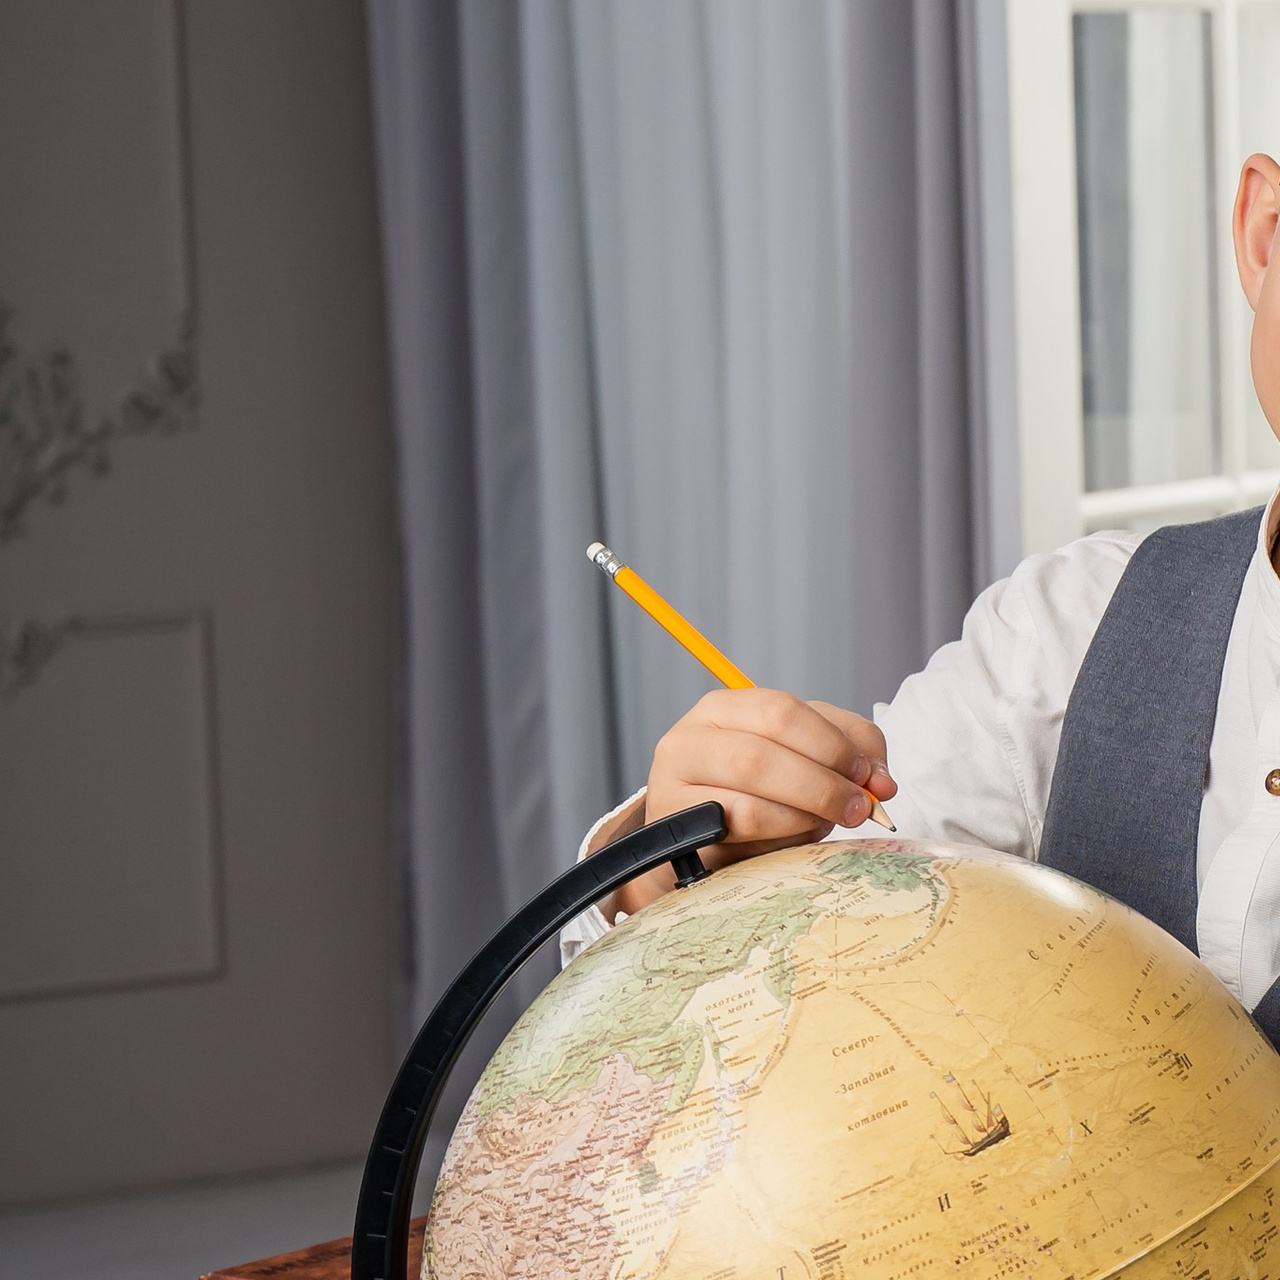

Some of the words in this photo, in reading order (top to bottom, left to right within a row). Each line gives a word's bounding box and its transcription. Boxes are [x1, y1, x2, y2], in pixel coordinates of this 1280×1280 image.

[705, 987, 757, 1012] ОХОТСКОЕ
[727, 1000, 755, 1015] МОРЕ
[831, 1033, 881, 1058] Северо-
[846, 1097, 910, 1133] котловина
